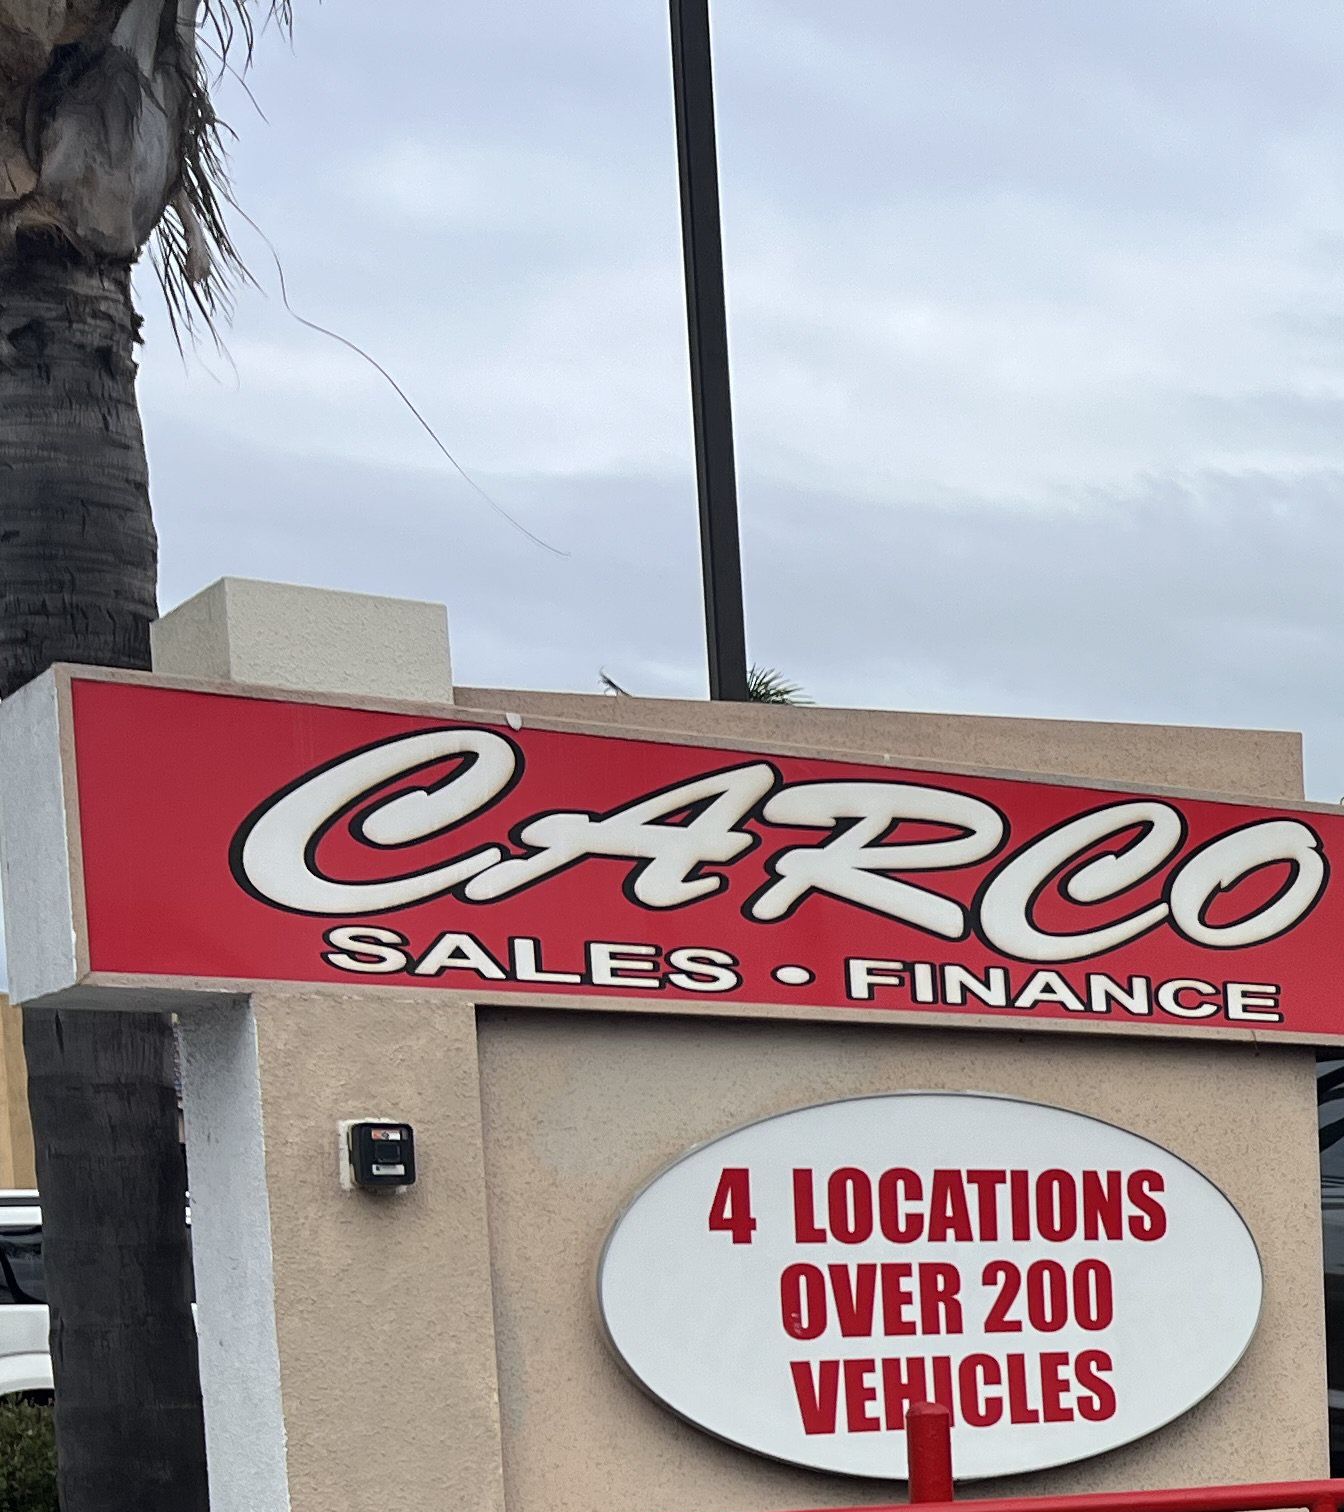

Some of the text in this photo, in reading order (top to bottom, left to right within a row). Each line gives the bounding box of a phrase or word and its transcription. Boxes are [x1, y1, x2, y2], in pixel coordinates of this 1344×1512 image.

[229, 725, 1331, 964] CARCO
[320, 924, 1284, 1023] SALES FINANCE
[708, 1167, 1167, 1245] 4 LOCATIONS
[780, 1259, 1113, 1341] OVER 200
[790, 1350, 1117, 1436] VEHICLES
